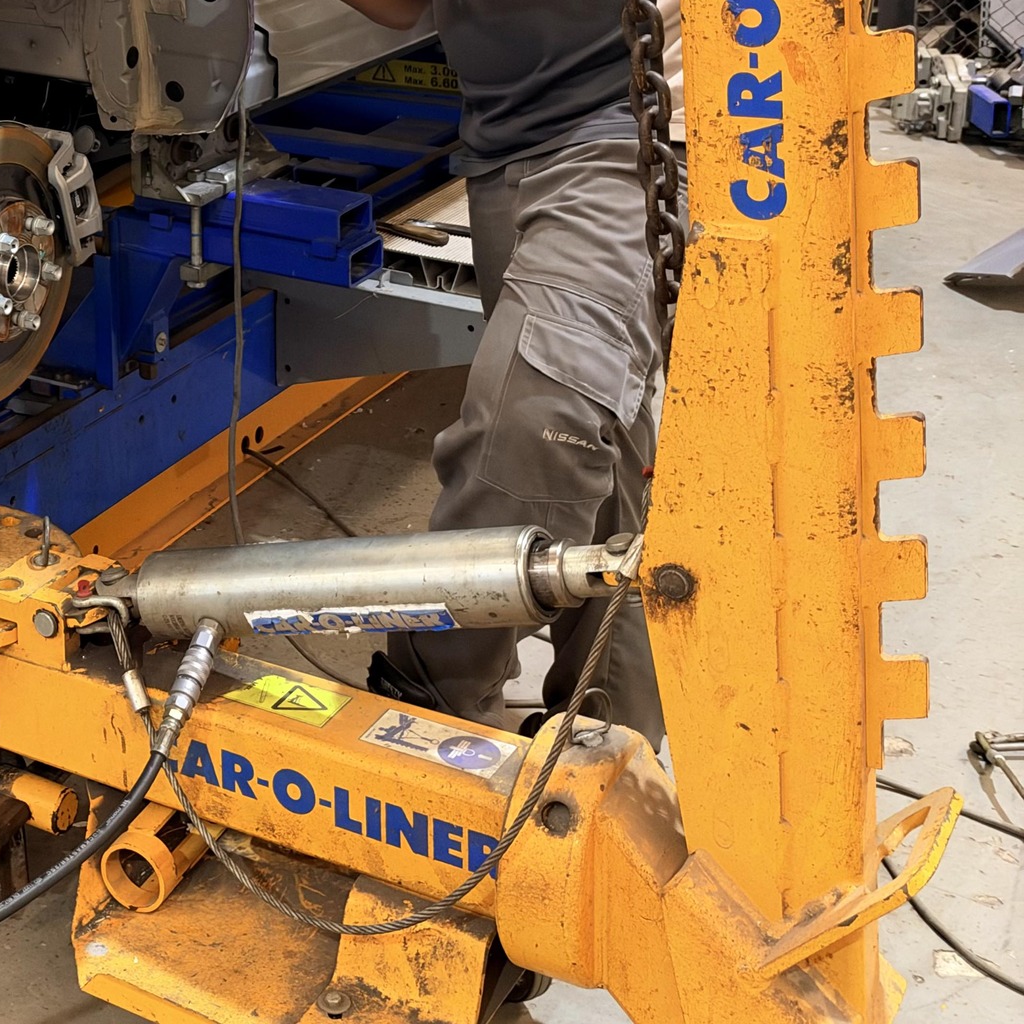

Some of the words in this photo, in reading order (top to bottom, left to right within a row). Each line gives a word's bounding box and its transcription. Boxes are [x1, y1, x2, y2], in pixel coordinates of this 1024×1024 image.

[404, 64, 426, 74] Max.
[430, 65, 458, 77] 3.00
[405, 76, 426, 86] Max.
[430, 76, 458, 89] 6.60
[542, 428, 599, 451] NISSAN
